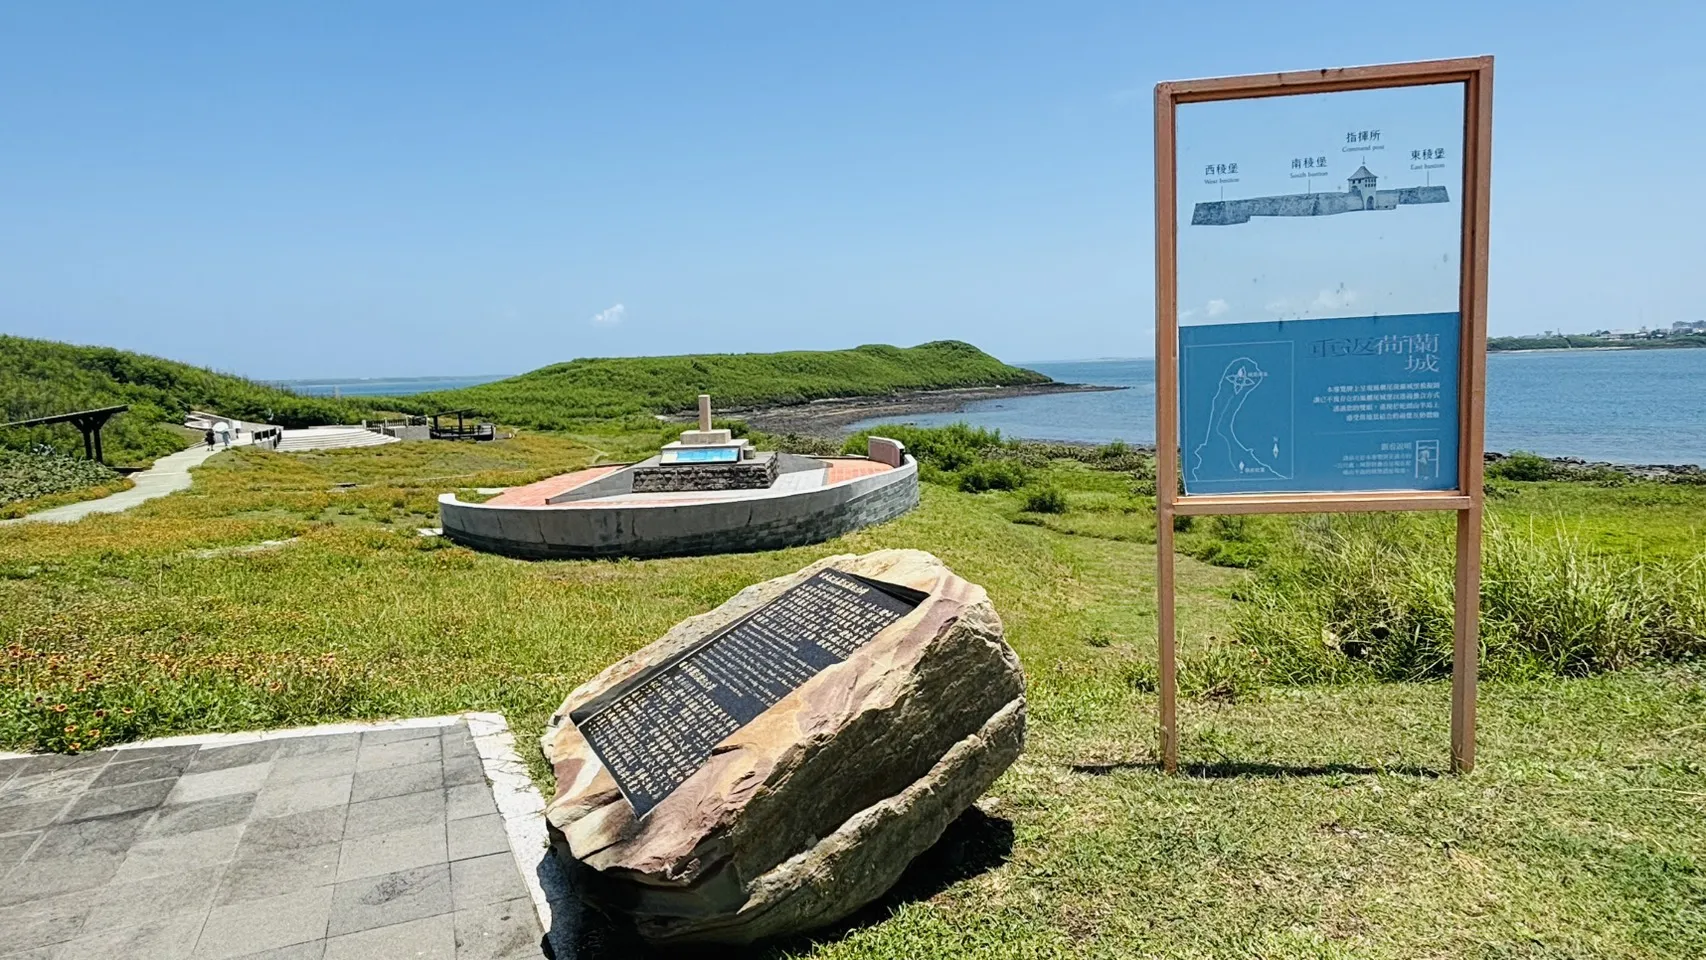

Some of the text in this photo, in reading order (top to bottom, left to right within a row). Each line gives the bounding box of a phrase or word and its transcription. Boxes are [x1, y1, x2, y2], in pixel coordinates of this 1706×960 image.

[1346, 129, 1381, 143] 指揮所
[1410, 147, 1445, 160] 東稜堡
[1205, 162, 1239, 176] 西稜堡
[1291, 156, 1328, 169] 南稜堡
[1404, 354, 1440, 374] 城
